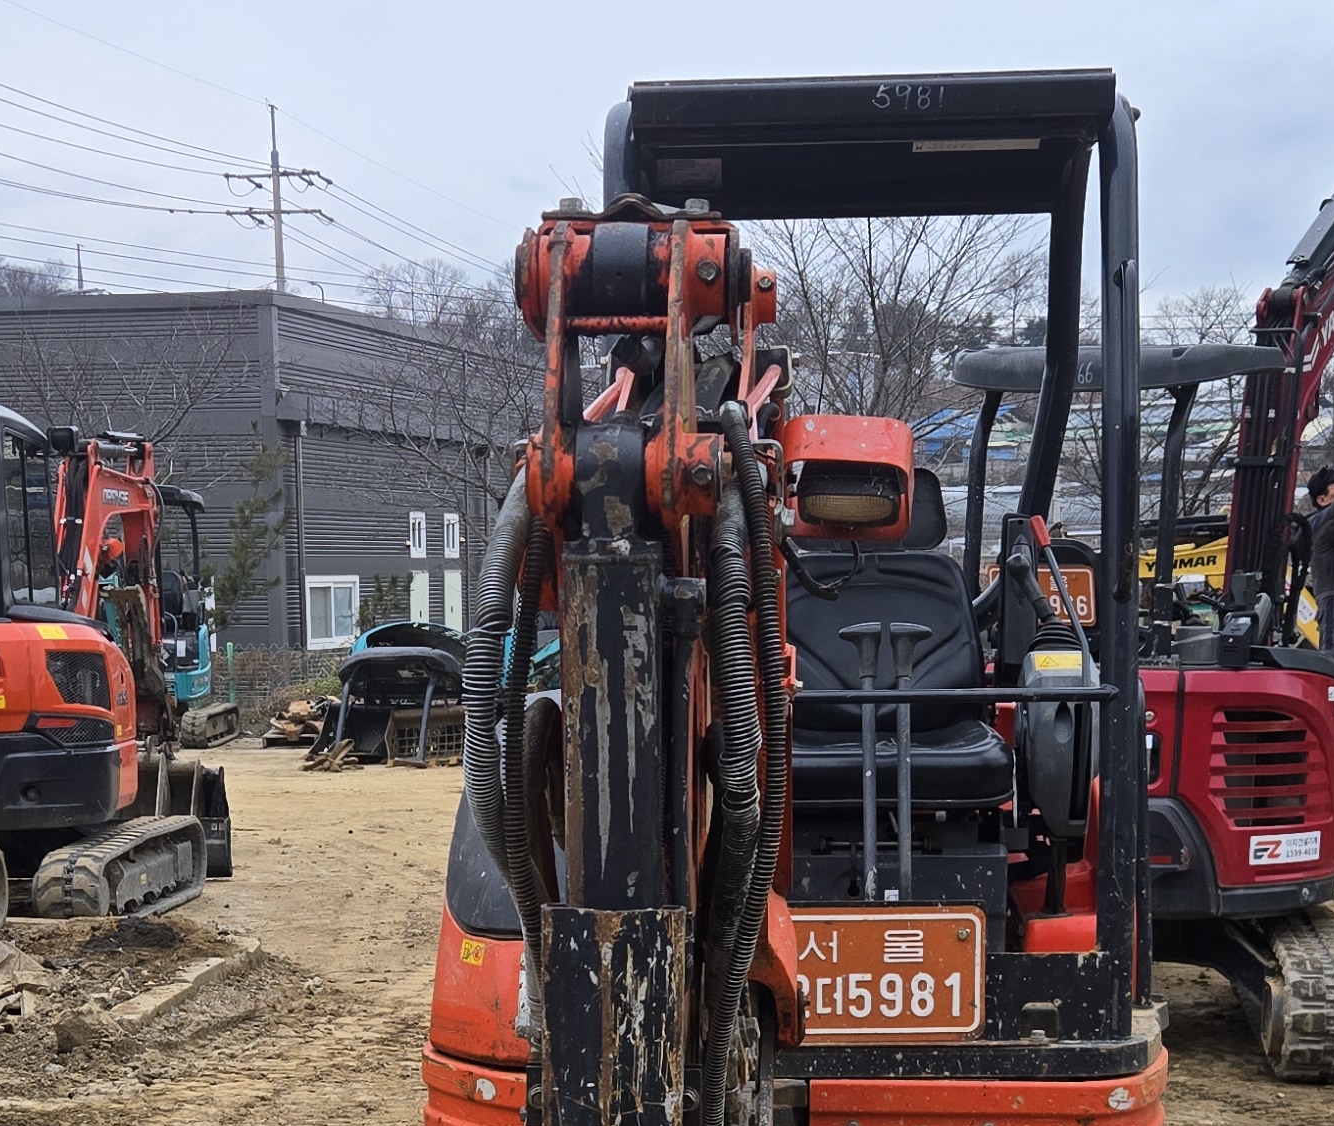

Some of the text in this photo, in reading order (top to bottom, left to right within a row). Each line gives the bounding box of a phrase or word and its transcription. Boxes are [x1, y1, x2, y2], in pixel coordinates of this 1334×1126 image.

[872, 83, 945, 110] 5981
[1145, 555, 1218, 573] YNMAR
[1252, 840, 1283, 859] EZ
